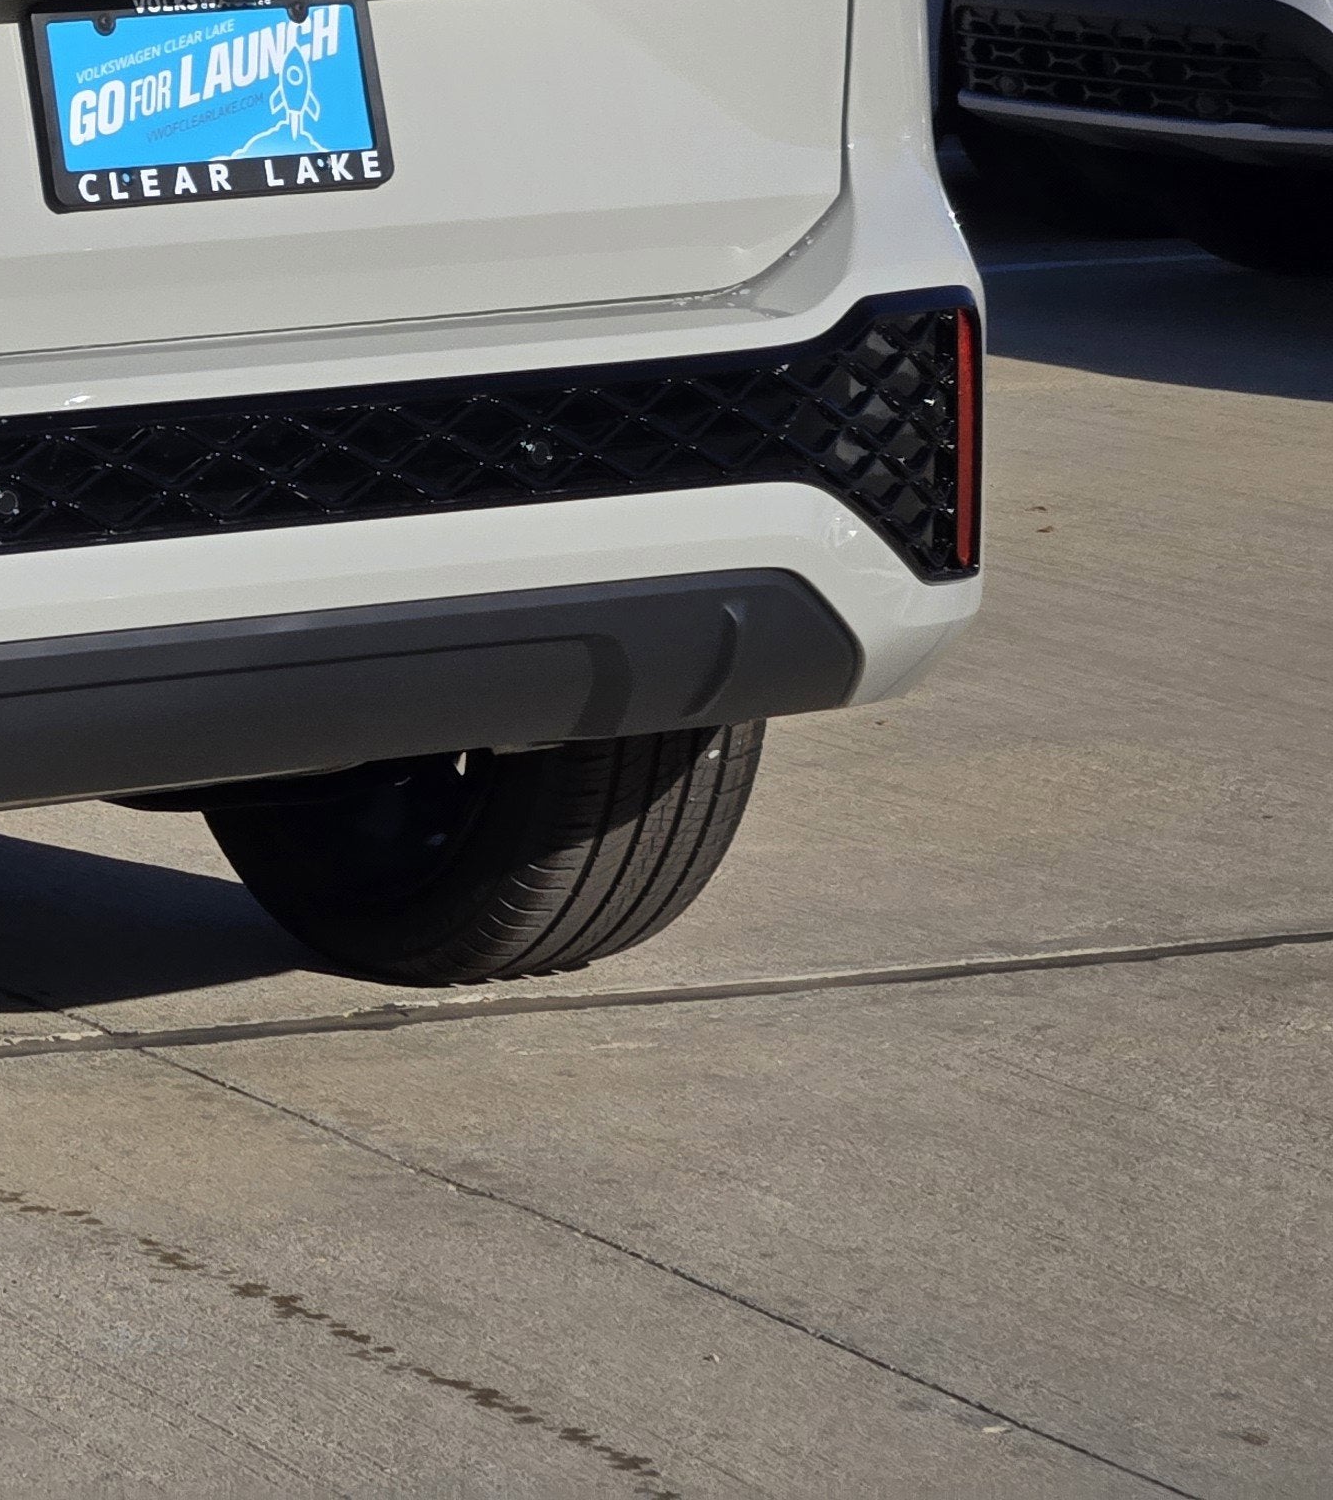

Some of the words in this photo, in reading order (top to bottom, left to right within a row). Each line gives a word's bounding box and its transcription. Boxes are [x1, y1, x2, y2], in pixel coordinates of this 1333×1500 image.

[69, 79, 126, 146] GO
[129, 69, 173, 122] FOR
[178, 4, 340, 109] LAUNCH
[76, 43, 162, 85] VOLKSWAGEN
[163, 29, 204, 55] CLEAR
[205, 18, 236, 41] LAKE
[147, 92, 264, 144] VWOFCLEARLAKE.COM
[78, 162, 233, 203] CLEAR
[264, 150, 382, 188] LAKE
